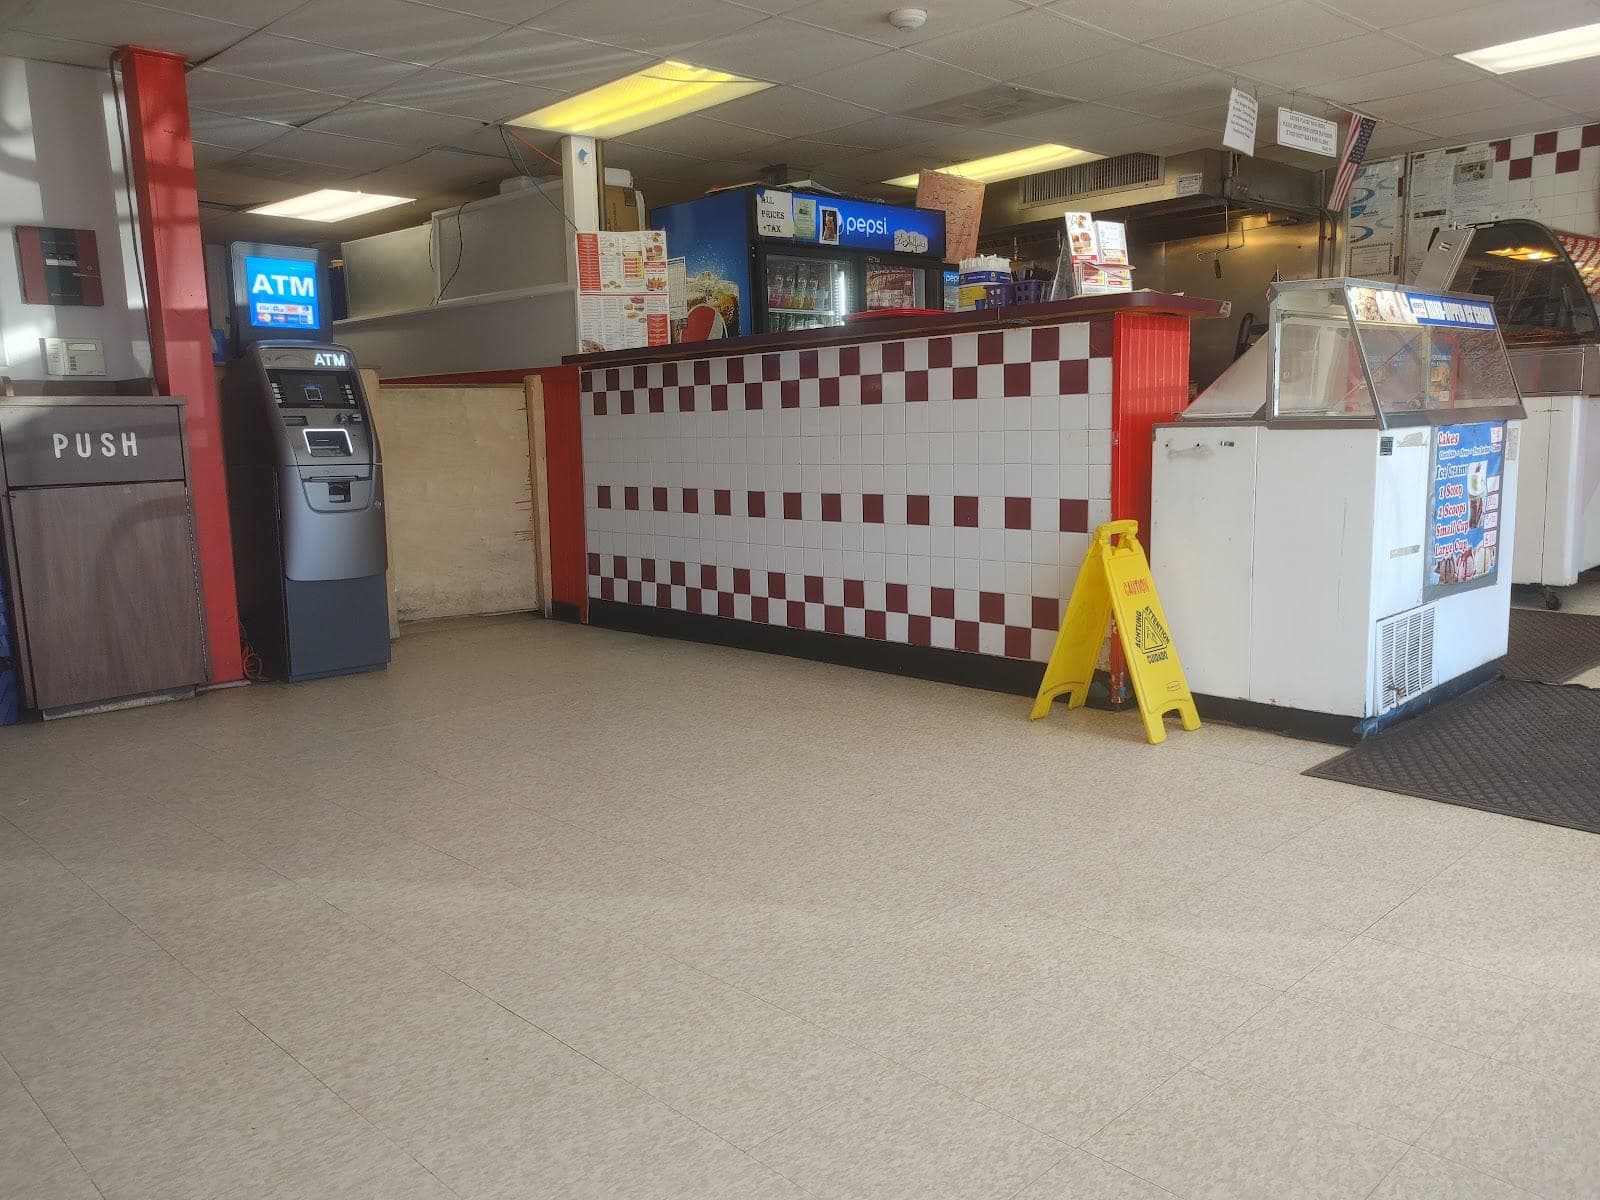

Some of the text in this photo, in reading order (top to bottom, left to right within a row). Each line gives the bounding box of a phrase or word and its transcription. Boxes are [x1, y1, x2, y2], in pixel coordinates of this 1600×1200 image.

[761, 210, 785, 219] PRICES
[846, 217, 887, 237] pepsi
[252, 273, 315, 297] ATM
[314, 353, 346, 367] ATM
[53, 432, 138, 459] PUSH
[1438, 431, 1459, 446] Cakes
[1436, 464, 1467, 480] Ice Cream
[1439, 483, 1463, 499] 1 Scoop
[1437, 507, 1443, 519] 2
[1436, 520, 1469, 538] Small Cup
[1435, 543, 1454, 558] Large
[1454, 539, 1468, 552] Cup
[1123, 578, 1150, 596] CAUTION
[1144, 606, 1170, 644] ATTENTION
[1146, 651, 1168, 664] CUIDADO
